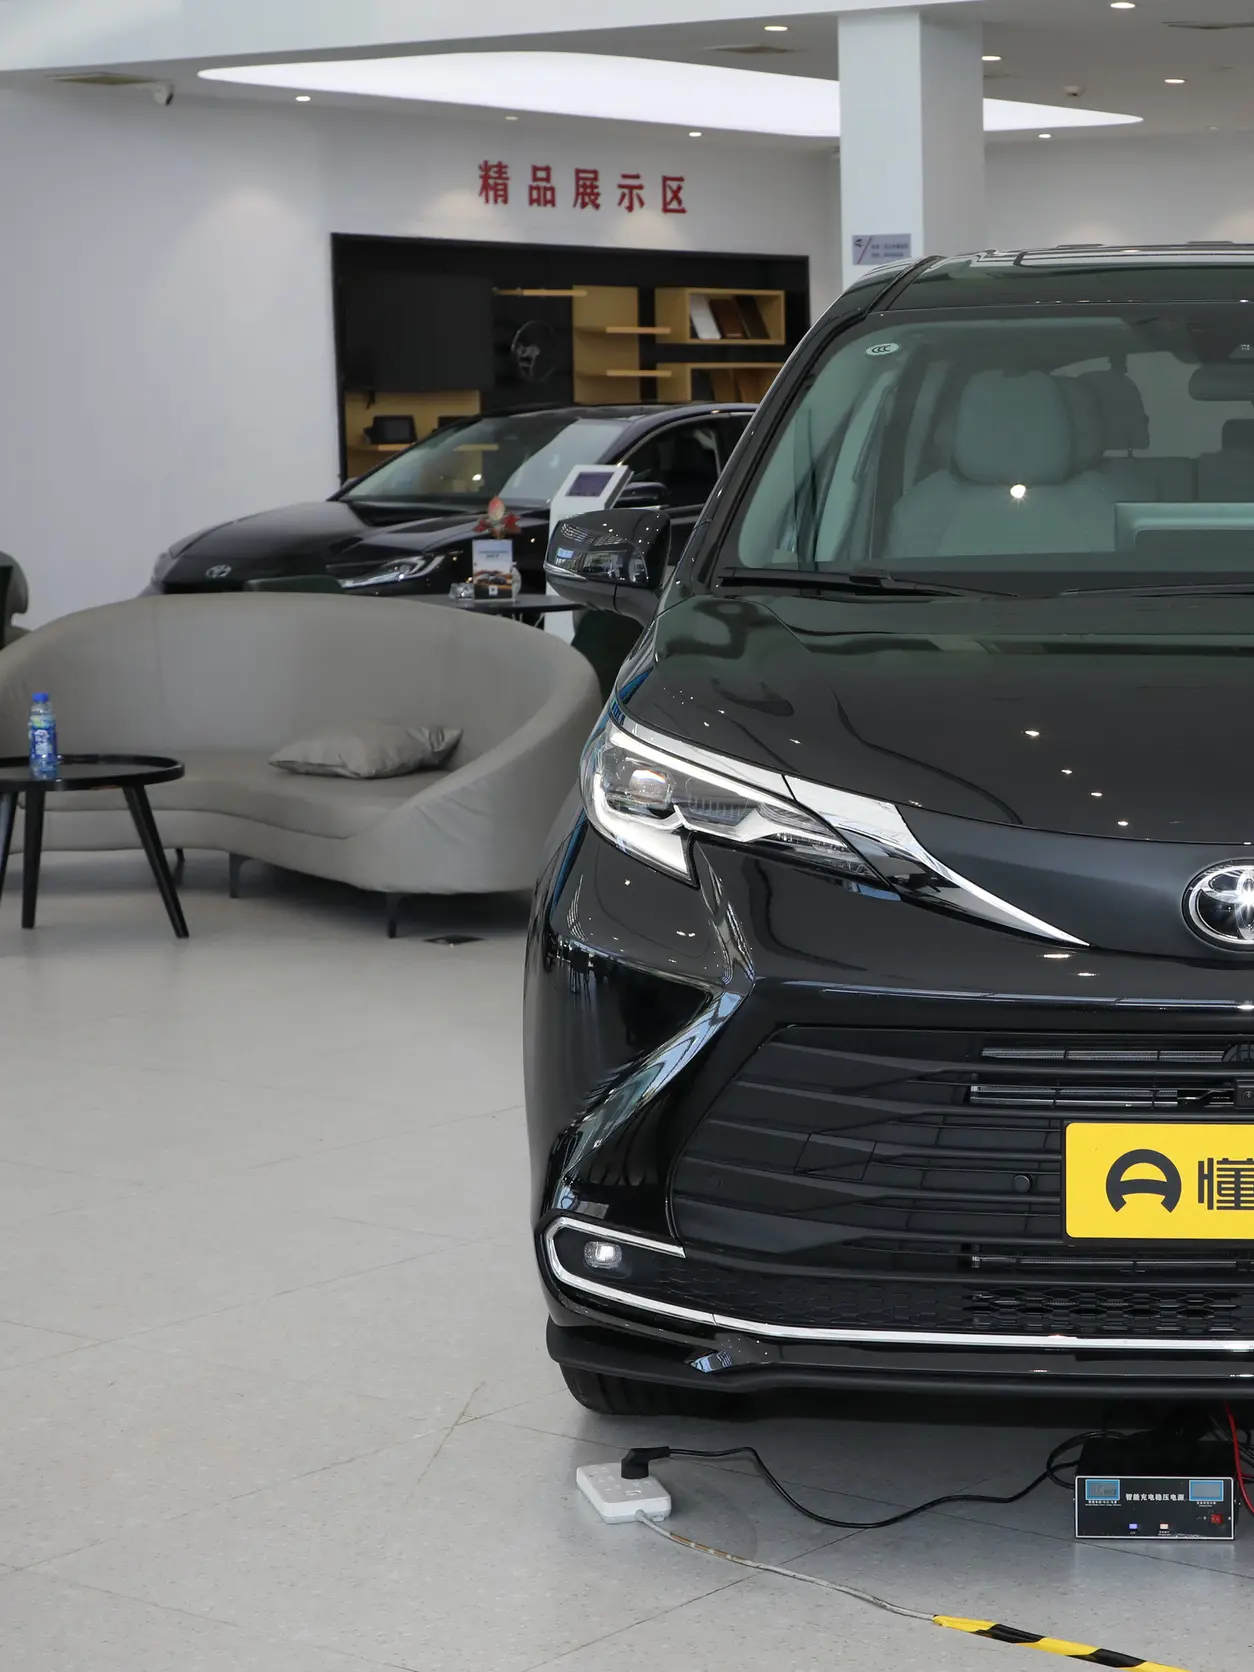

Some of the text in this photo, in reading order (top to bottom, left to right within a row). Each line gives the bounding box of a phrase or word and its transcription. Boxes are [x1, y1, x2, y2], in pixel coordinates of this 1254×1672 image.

[479, 160, 687, 214] 精品展示区
[1125, 1493, 1185, 1501] 智能充电稳压电源
